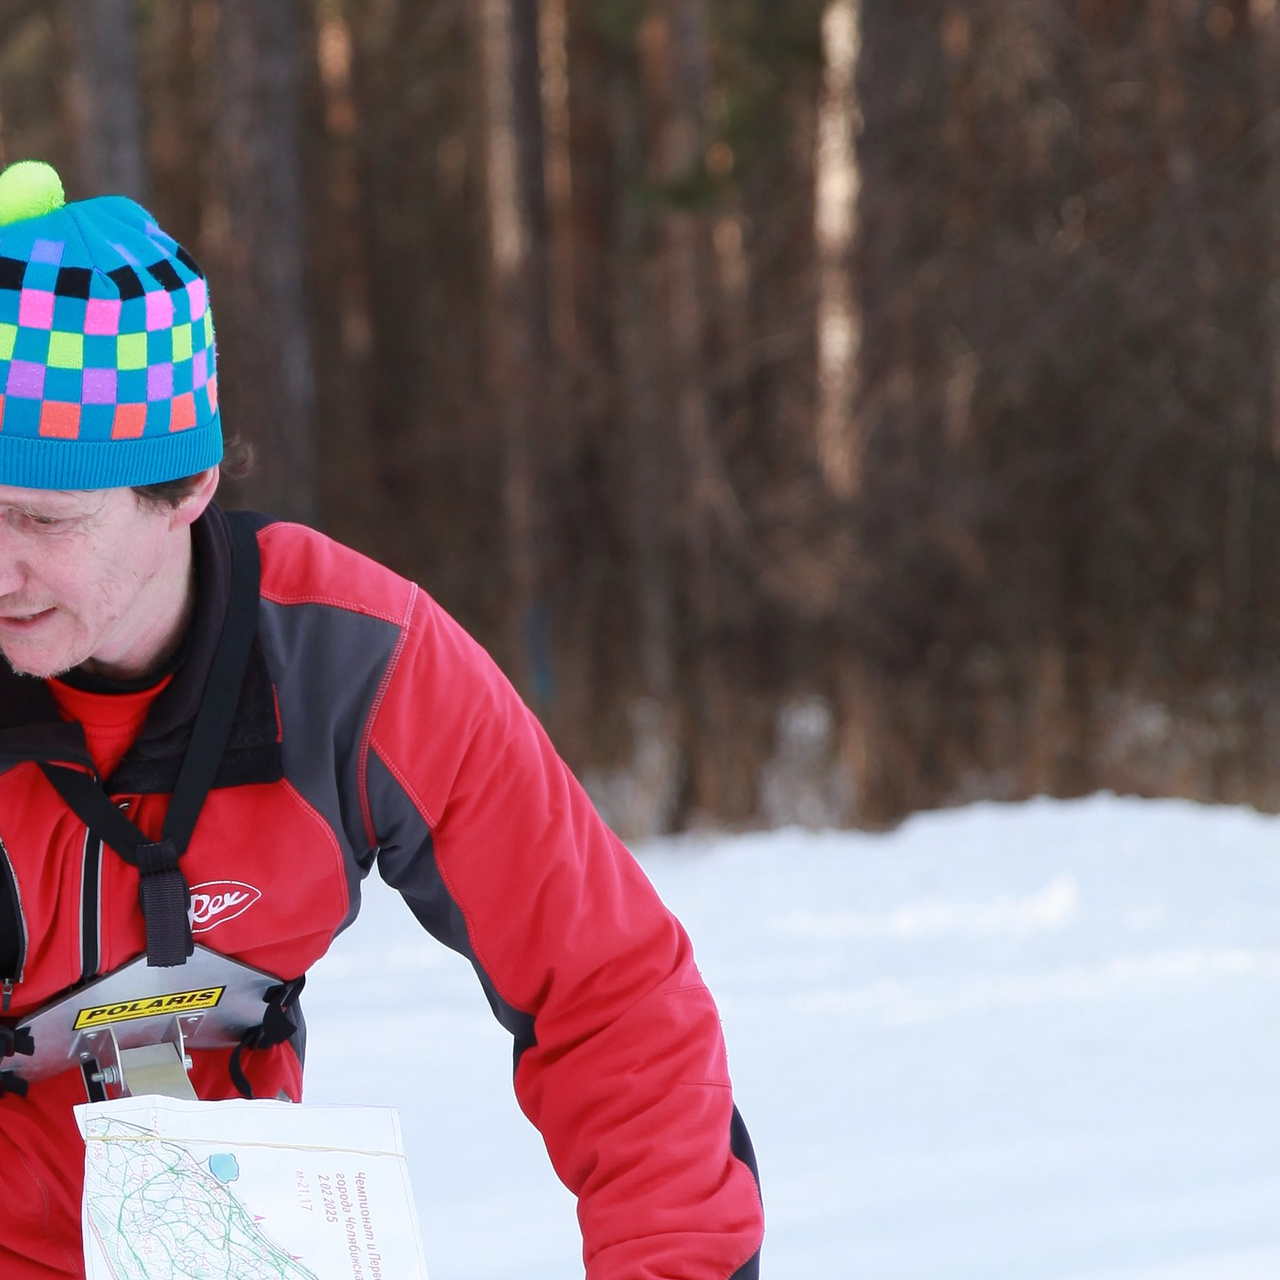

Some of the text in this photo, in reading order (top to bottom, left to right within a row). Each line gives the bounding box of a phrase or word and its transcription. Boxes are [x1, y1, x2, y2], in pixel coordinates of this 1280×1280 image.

[187, 891, 250, 931] Rex
[86, 990, 216, 1020] POLARIS
[318, 1174, 338, 1223] 2.02.2025
[336, 1173, 353, 1214] города
[355, 1171, 375, 1241] Чемпионат
